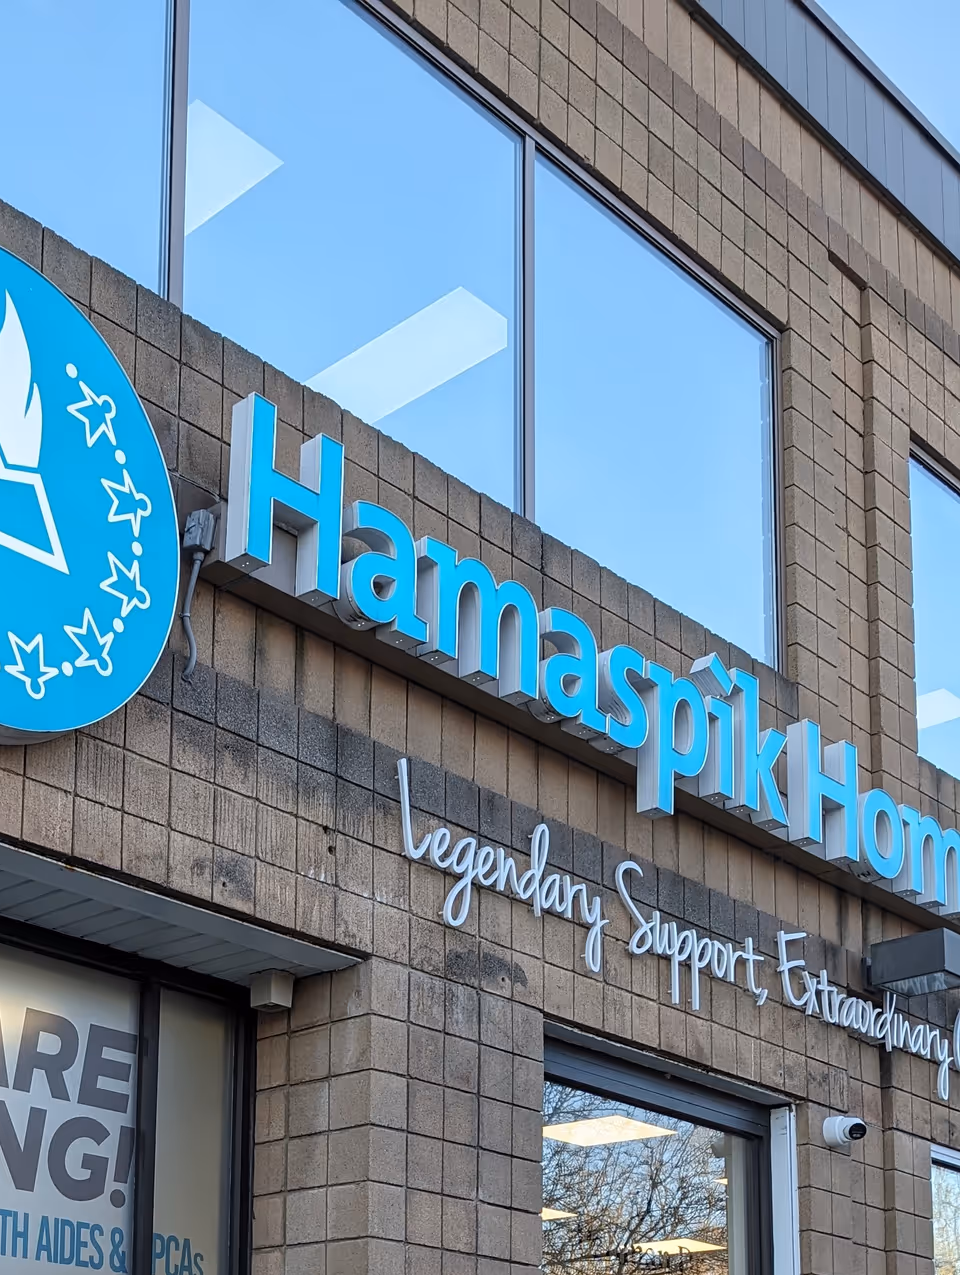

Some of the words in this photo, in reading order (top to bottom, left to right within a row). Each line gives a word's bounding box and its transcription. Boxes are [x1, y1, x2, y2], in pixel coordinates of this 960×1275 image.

[396, 757, 609, 974] Legendary
[615, 860, 768, 1011] Support,
[776, 930, 954, 1101] Extraordinary
[35, 1217, 104, 1271] AIDES
[109, 1234, 128, 1274] &
